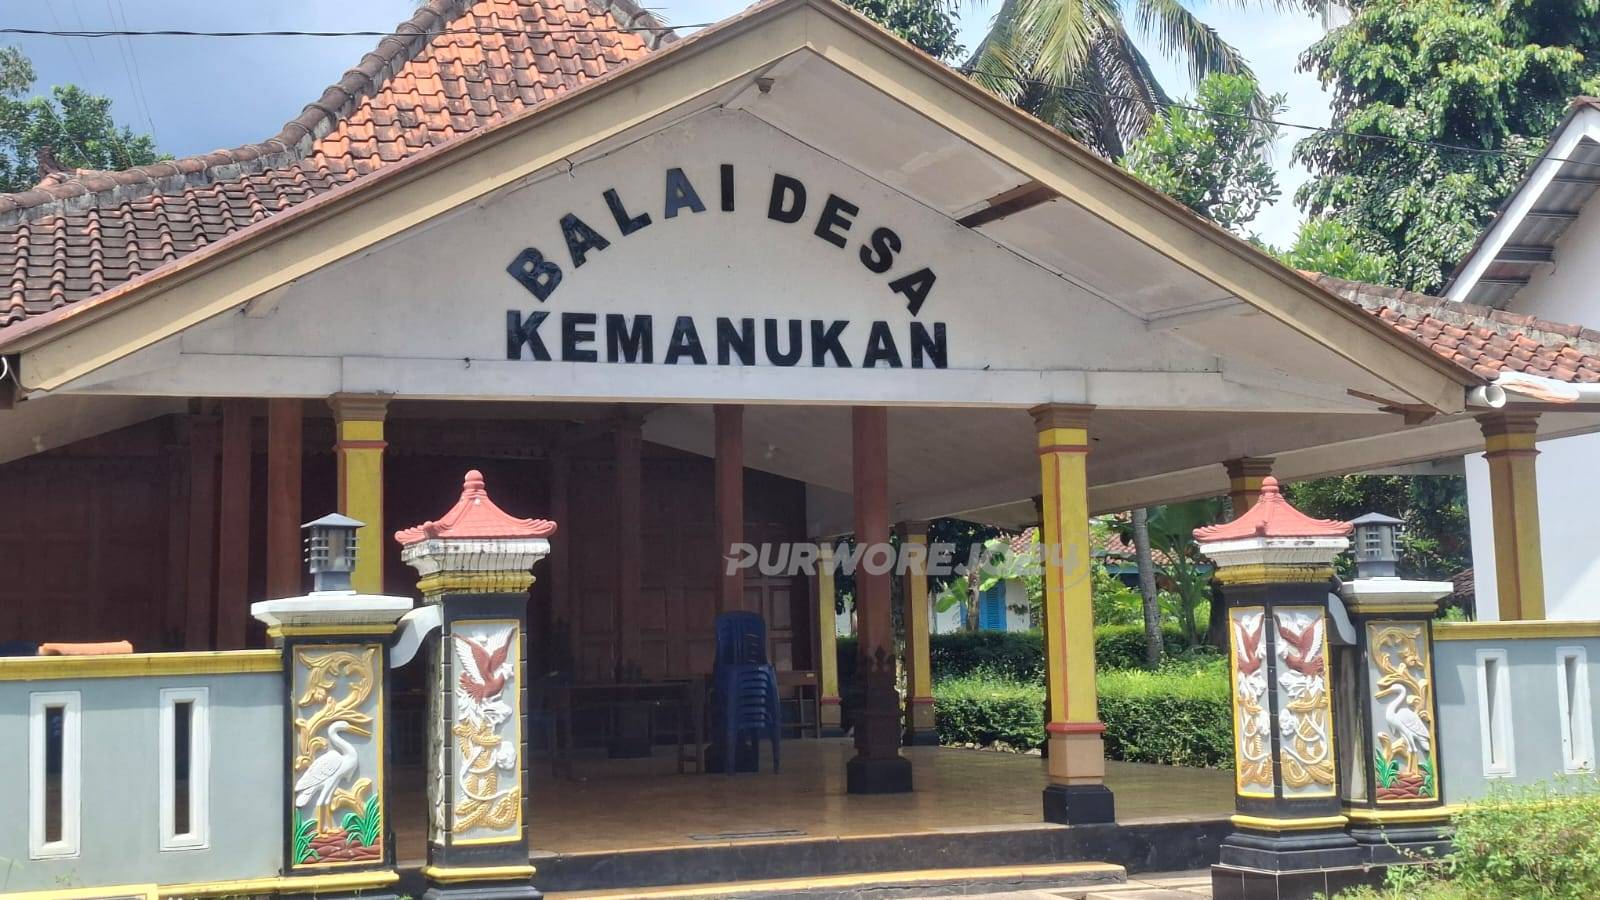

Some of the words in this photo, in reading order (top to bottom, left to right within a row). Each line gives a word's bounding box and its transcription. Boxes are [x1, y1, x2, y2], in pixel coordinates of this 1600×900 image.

[506, 164, 734, 302] BALAI
[768, 173, 937, 317] DESA
[506, 309, 948, 369] KEMANUKAN
